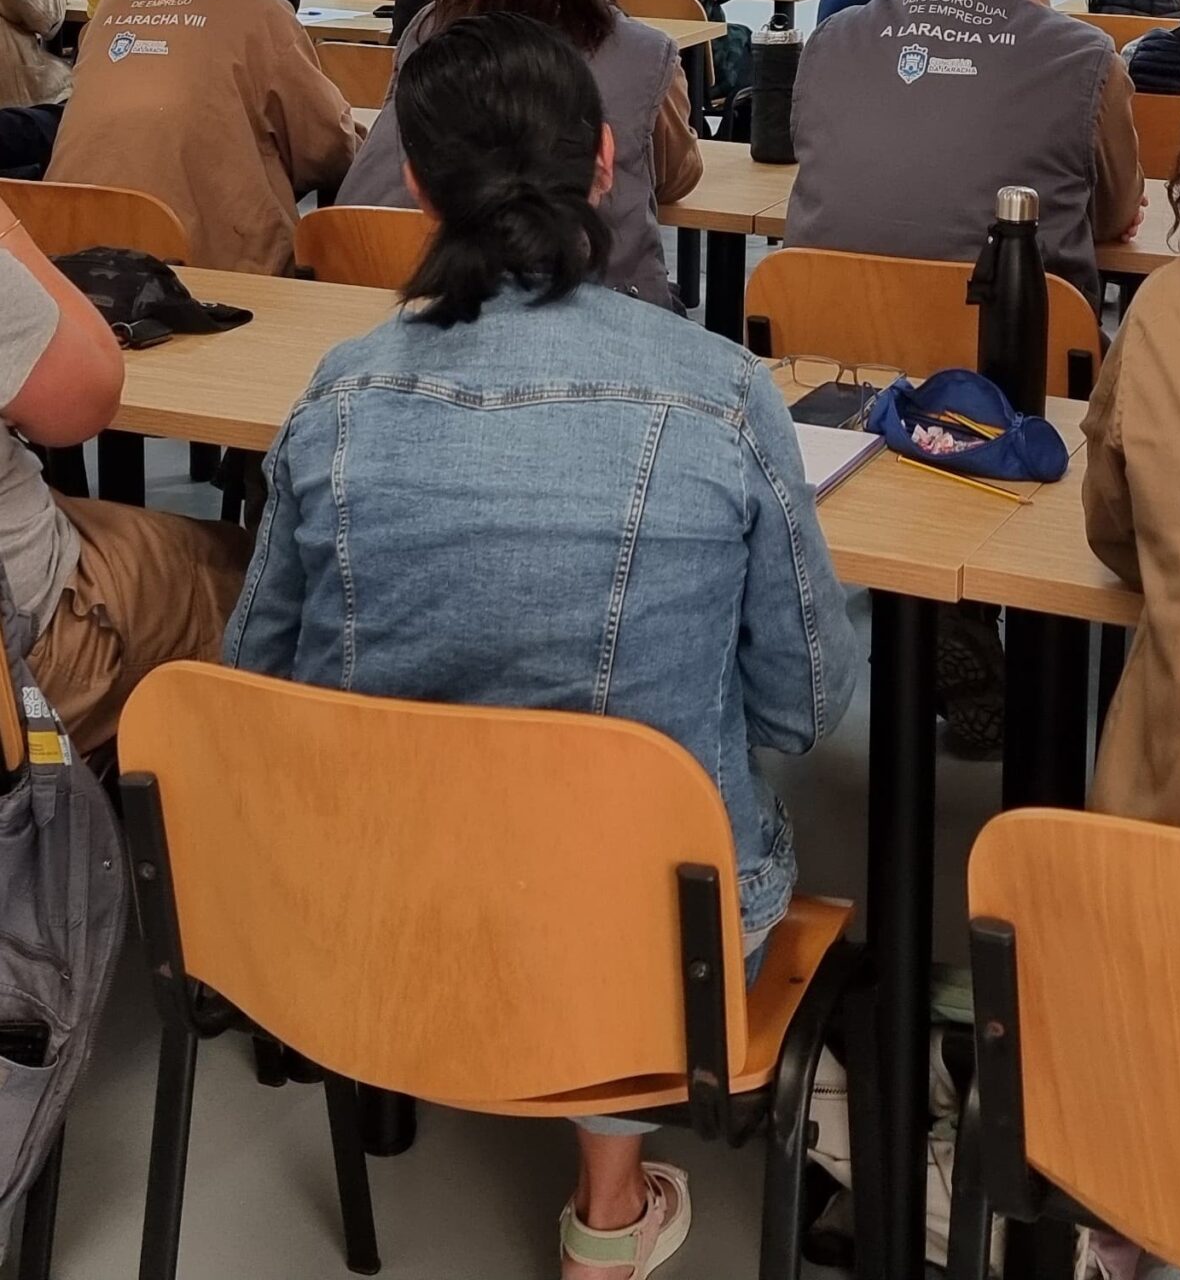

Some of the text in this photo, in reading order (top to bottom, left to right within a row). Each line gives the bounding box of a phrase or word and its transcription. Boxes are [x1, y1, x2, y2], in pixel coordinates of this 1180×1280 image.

[131, 0, 145, 8] DE
[975, 1, 1009, 19] DUAL
[103, 14, 207, 27] A LARACHA VIII
[908, 4, 993, 25] DE EMPREGO
[880, 23, 1016, 45] A LARACHA VIII
